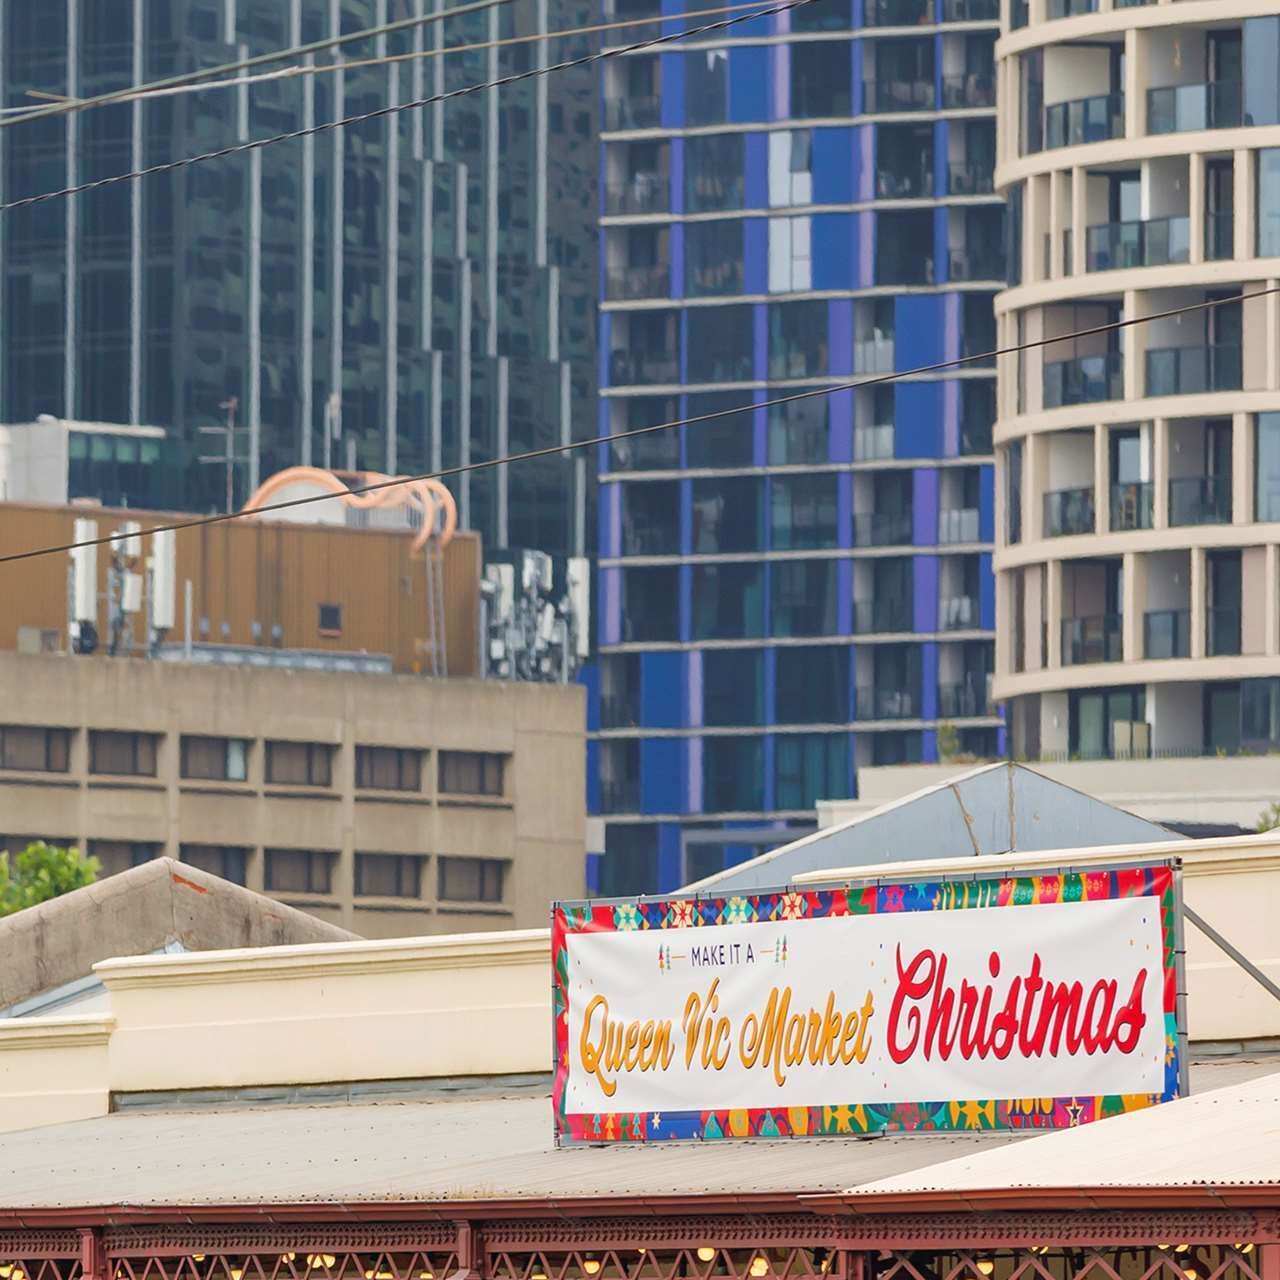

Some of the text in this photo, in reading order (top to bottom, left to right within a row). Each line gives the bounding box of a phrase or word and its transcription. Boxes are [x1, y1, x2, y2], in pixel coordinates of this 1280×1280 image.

[691, 943, 756, 966] MAKE IT A
[886, 942, 1148, 1064] Christmas
[580, 977, 876, 1097] Queen Vic Market
